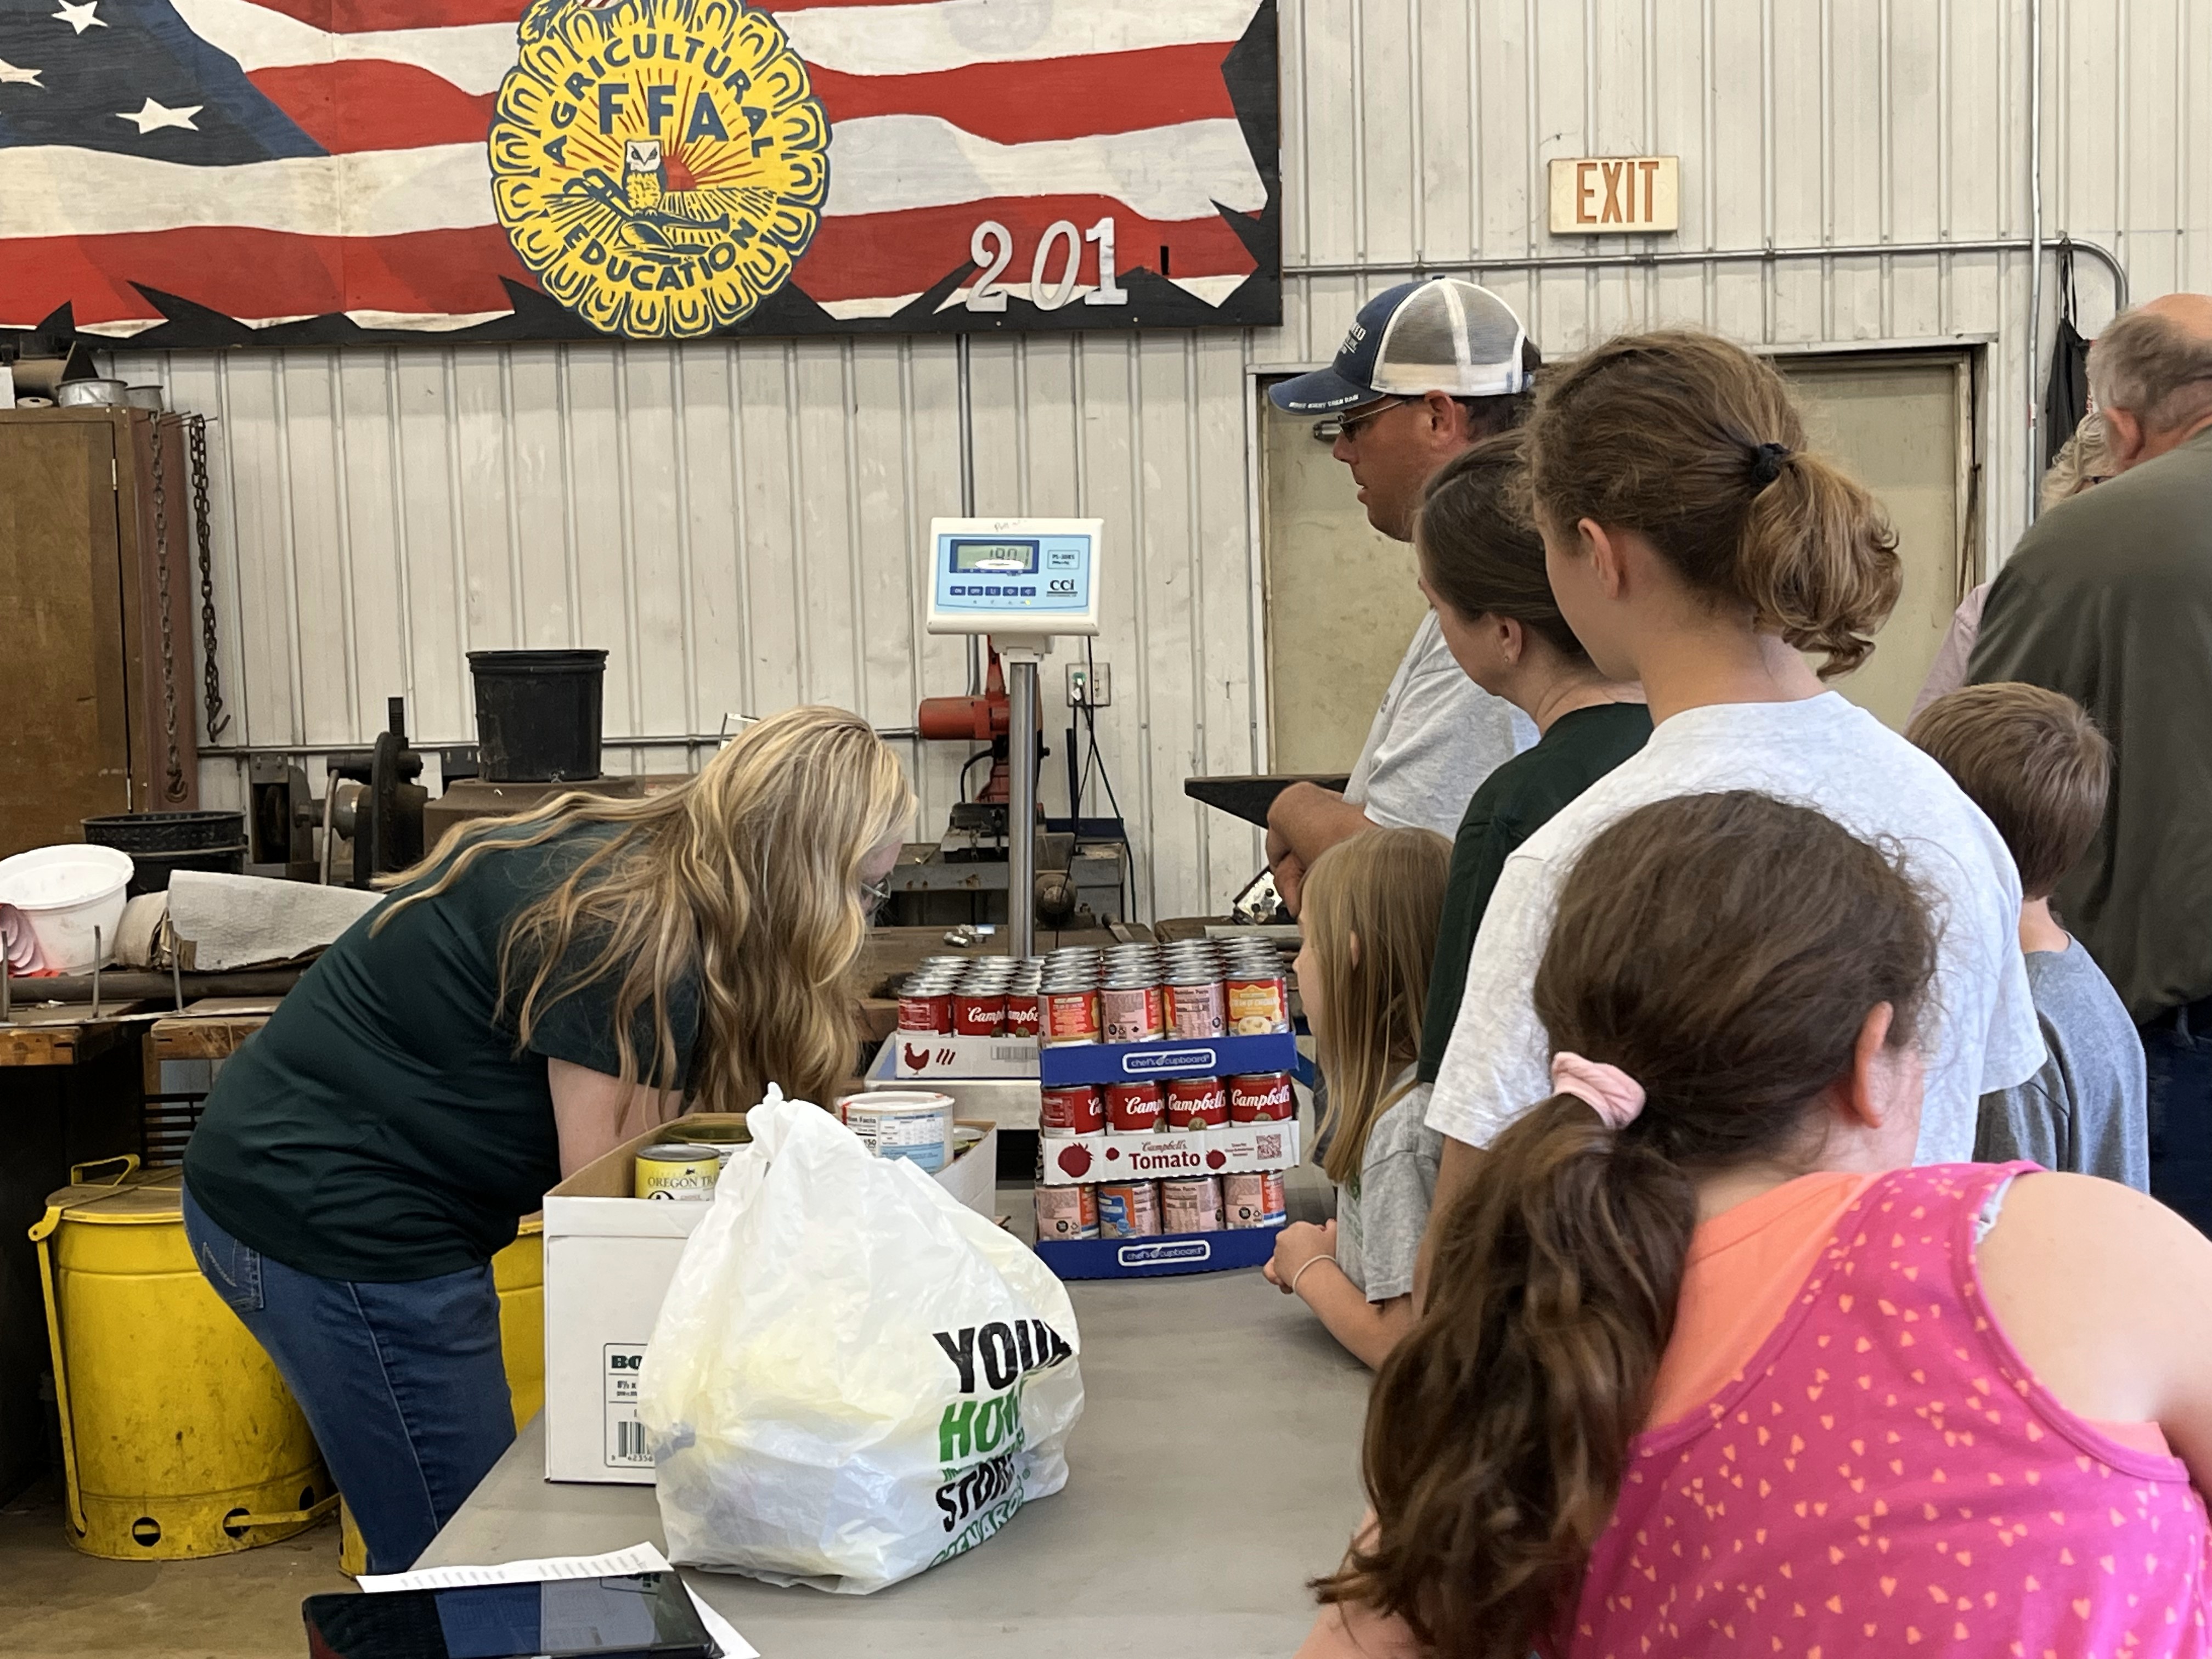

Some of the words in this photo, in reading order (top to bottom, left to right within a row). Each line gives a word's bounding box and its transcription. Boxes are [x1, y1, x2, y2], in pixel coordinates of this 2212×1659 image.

[543, 33, 774, 165] AGRICULTURAL
[598, 83, 729, 143] FFA
[1576, 161, 1649, 224] EXIT
[564, 217, 758, 291] EDUCATION
[965, 217, 1128, 312] 201
[647, 1177, 697, 1188] OREGON
[1128, 1152, 1200, 1171] Tomato
